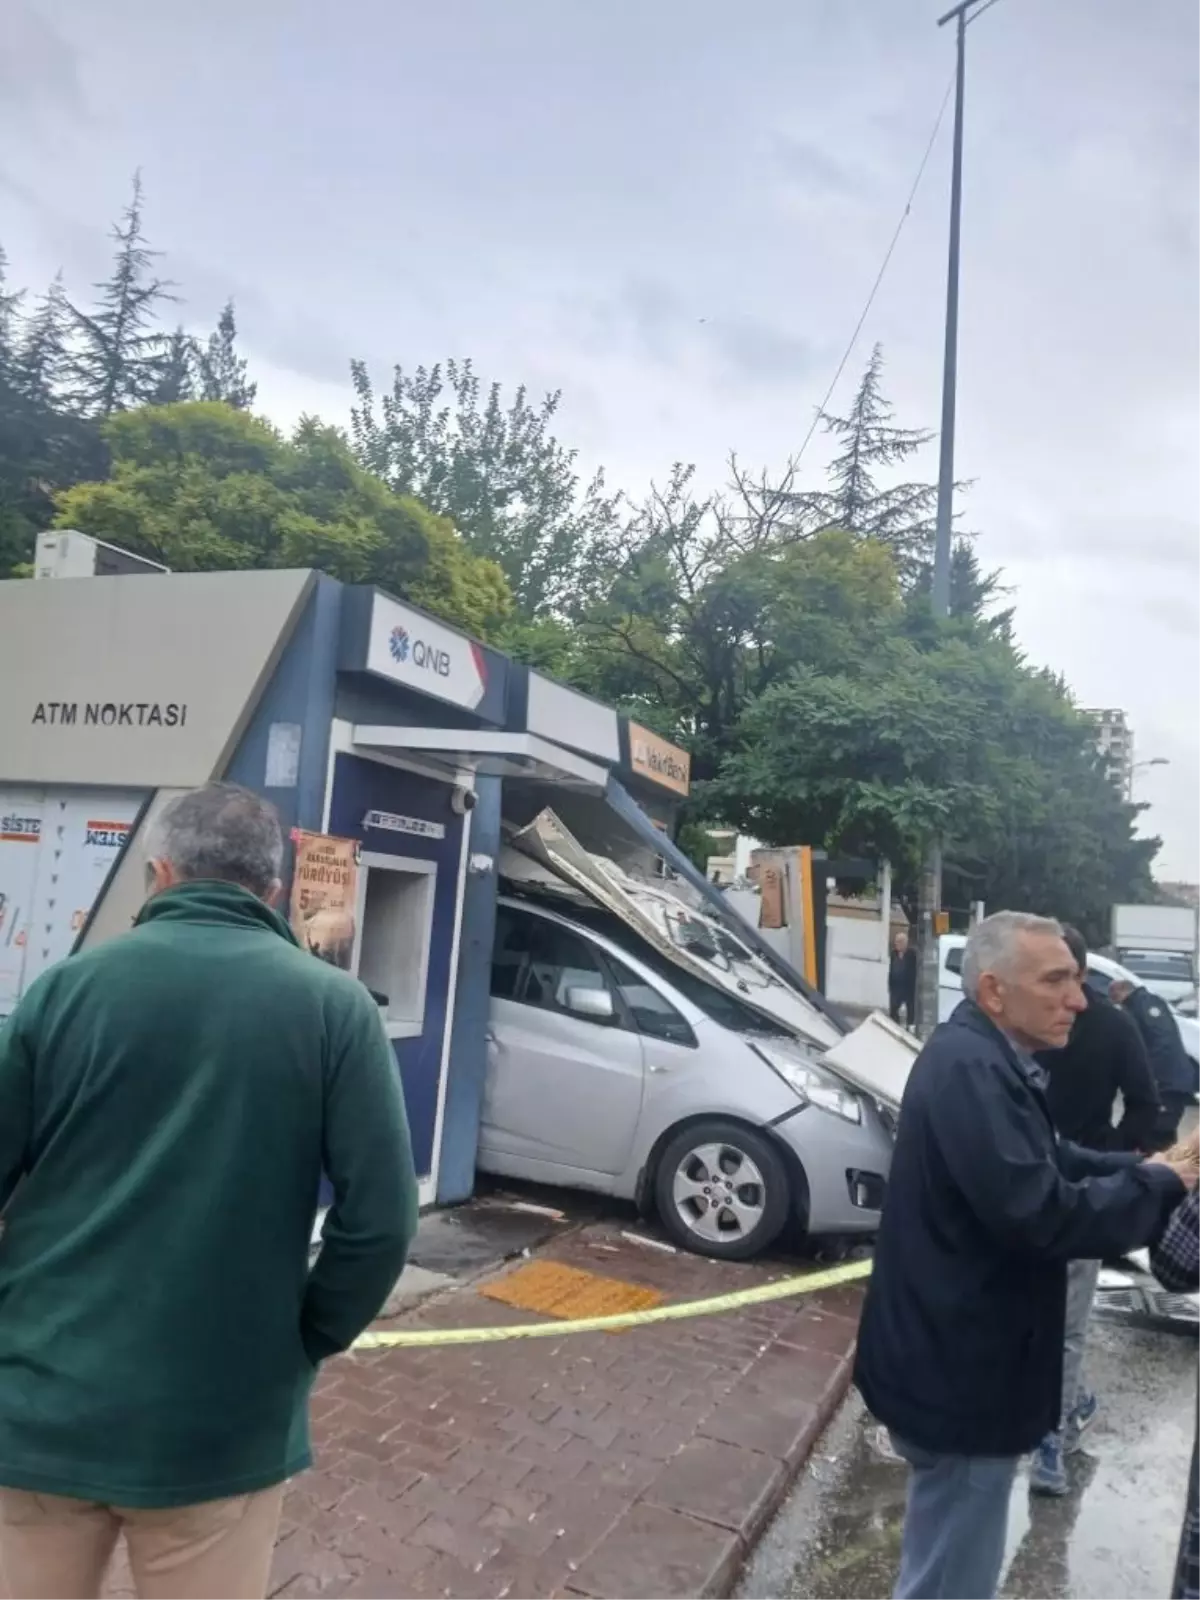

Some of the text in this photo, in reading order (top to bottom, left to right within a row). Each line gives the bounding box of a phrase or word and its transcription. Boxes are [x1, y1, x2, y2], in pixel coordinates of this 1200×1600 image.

[412, 639, 451, 677] QNB
[31, 702, 187, 727] ATM NOKTASI
